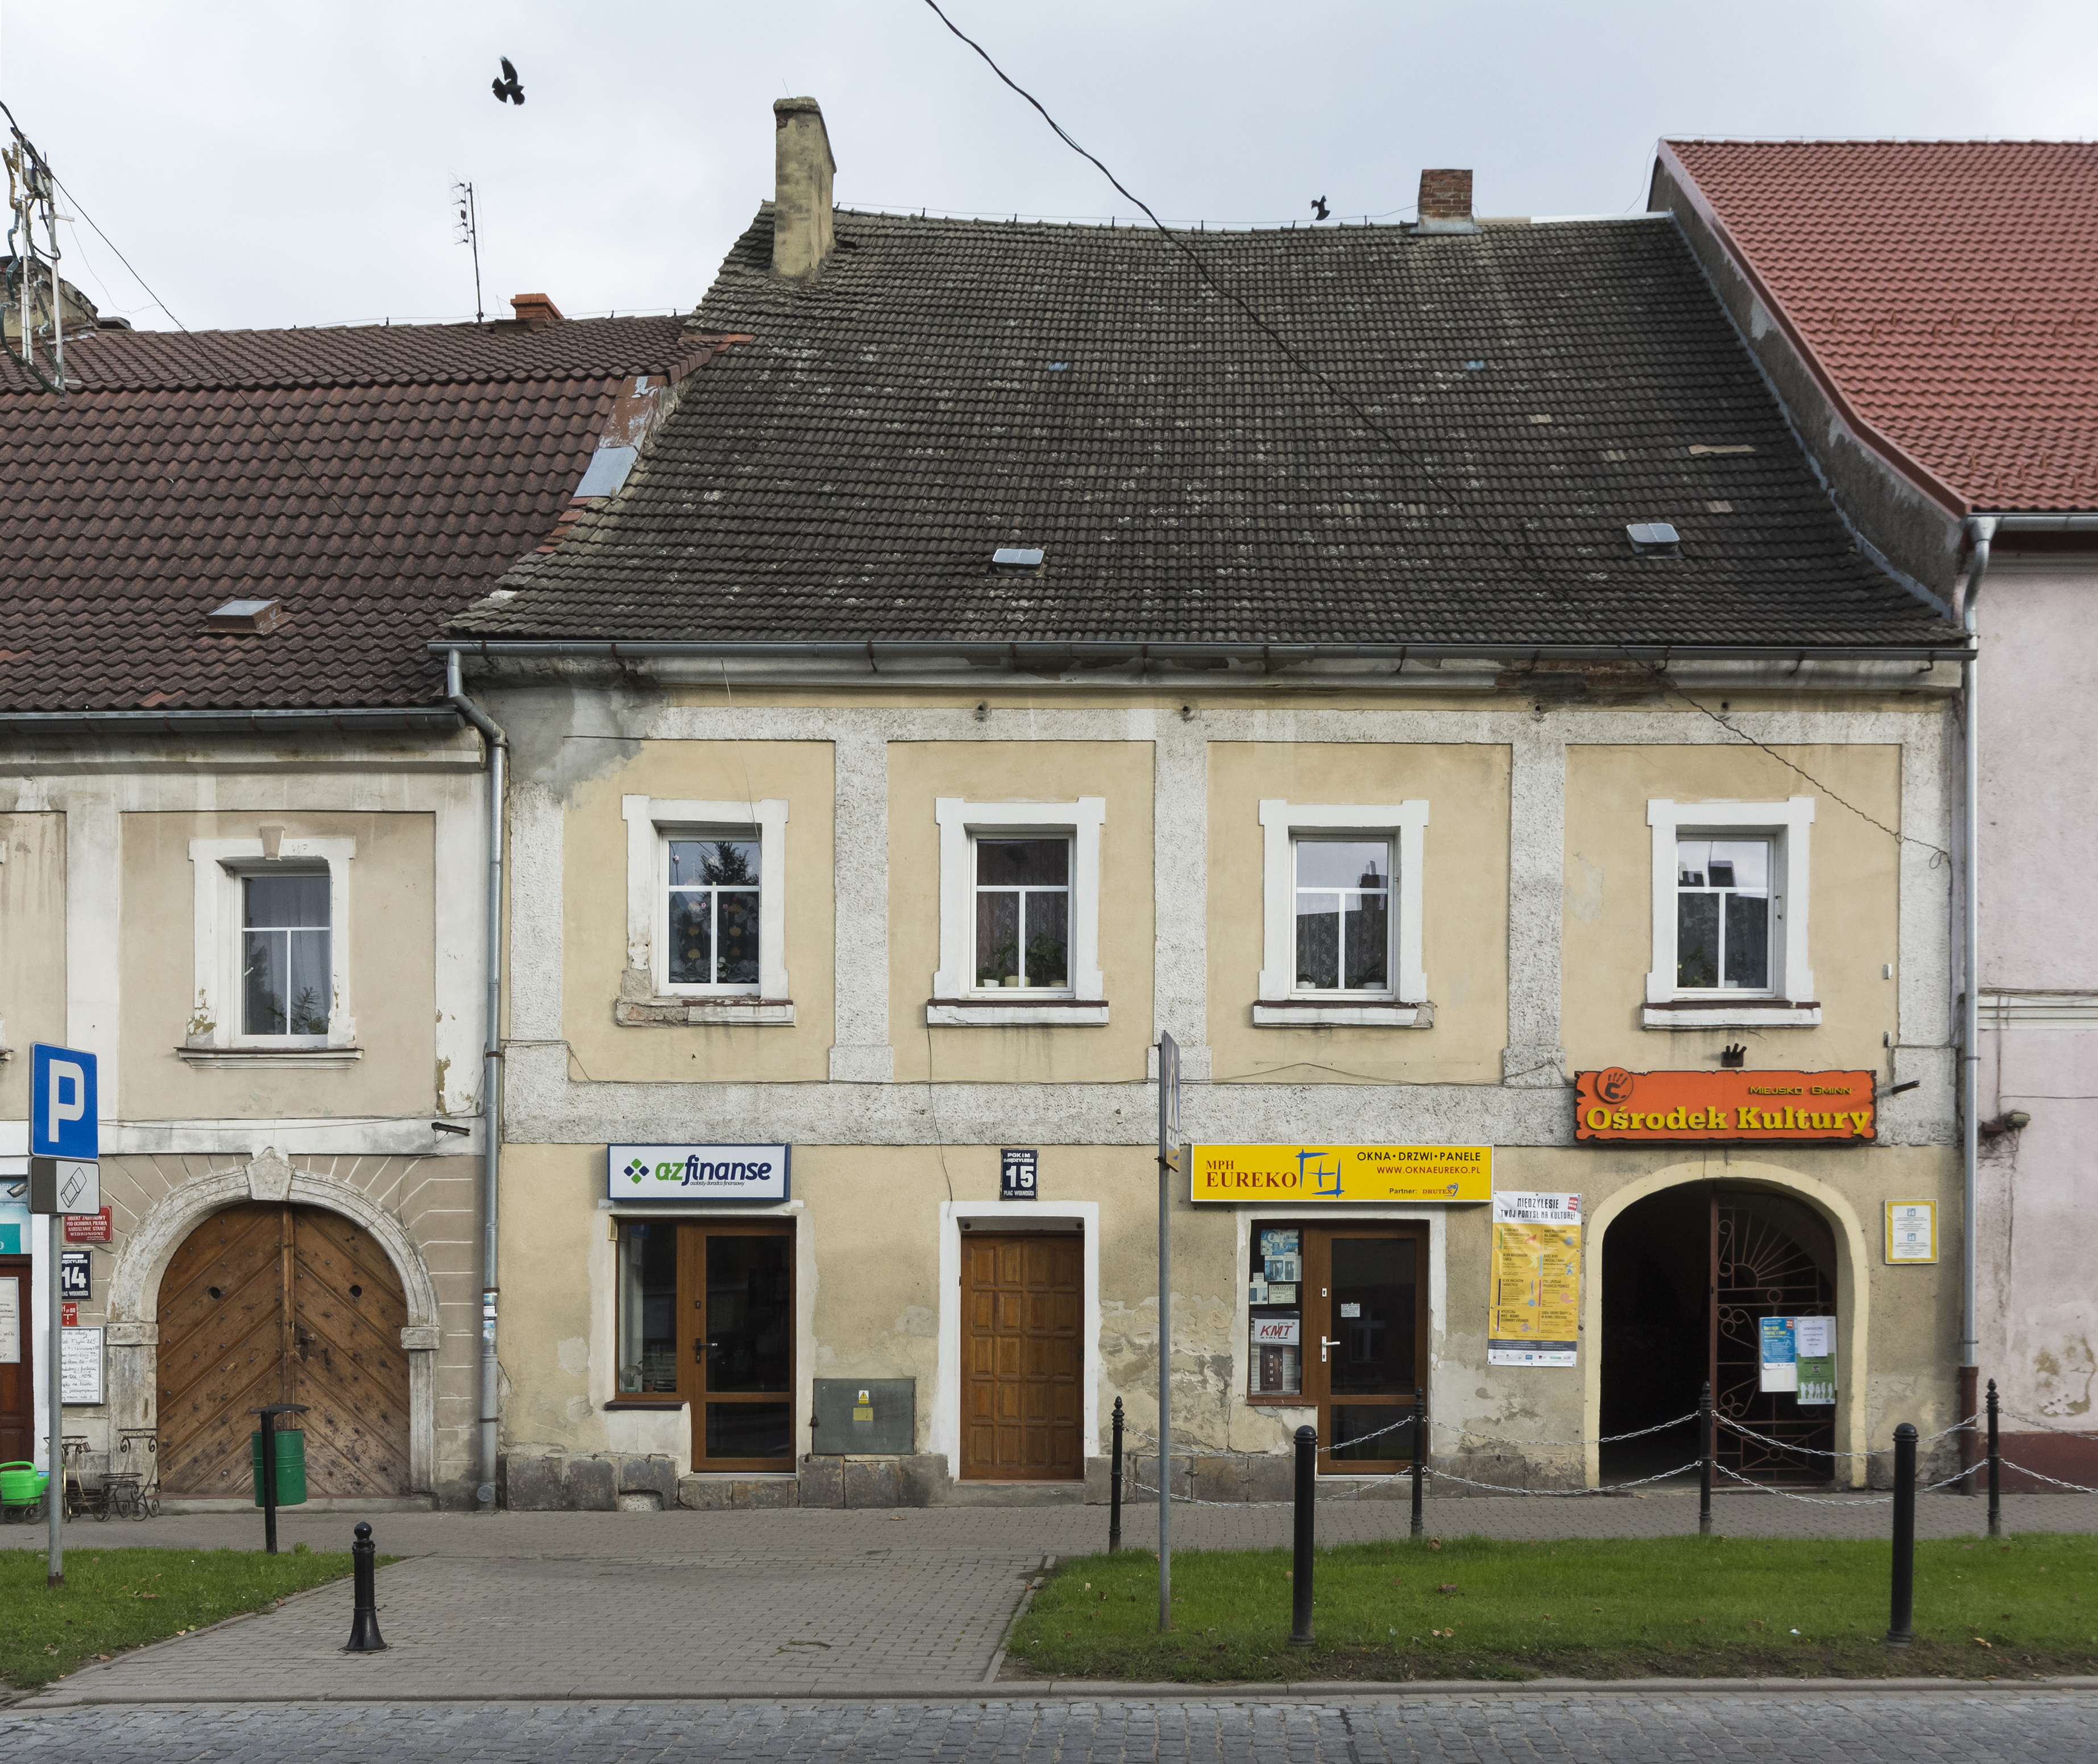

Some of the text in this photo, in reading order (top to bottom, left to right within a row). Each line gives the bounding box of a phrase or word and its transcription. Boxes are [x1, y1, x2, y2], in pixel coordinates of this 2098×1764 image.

[49, 1059, 84, 1142] P
[1586, 1106, 1870, 1134] Ośrodek Kultury
[1206, 1160, 1234, 1170] MPH
[1006, 1166, 1034, 1187] 15
[1206, 1172, 1297, 1187] EUREKO
[1517, 1198, 1559, 1208] MIĘDZYLESIE
[1500, 1208, 1516, 1218] TWÓJ
[1518, 1210, 1539, 1218] POMYSŁ
[61, 1266, 86, 1288] 14
[1260, 1326, 1293, 1336] KMT
